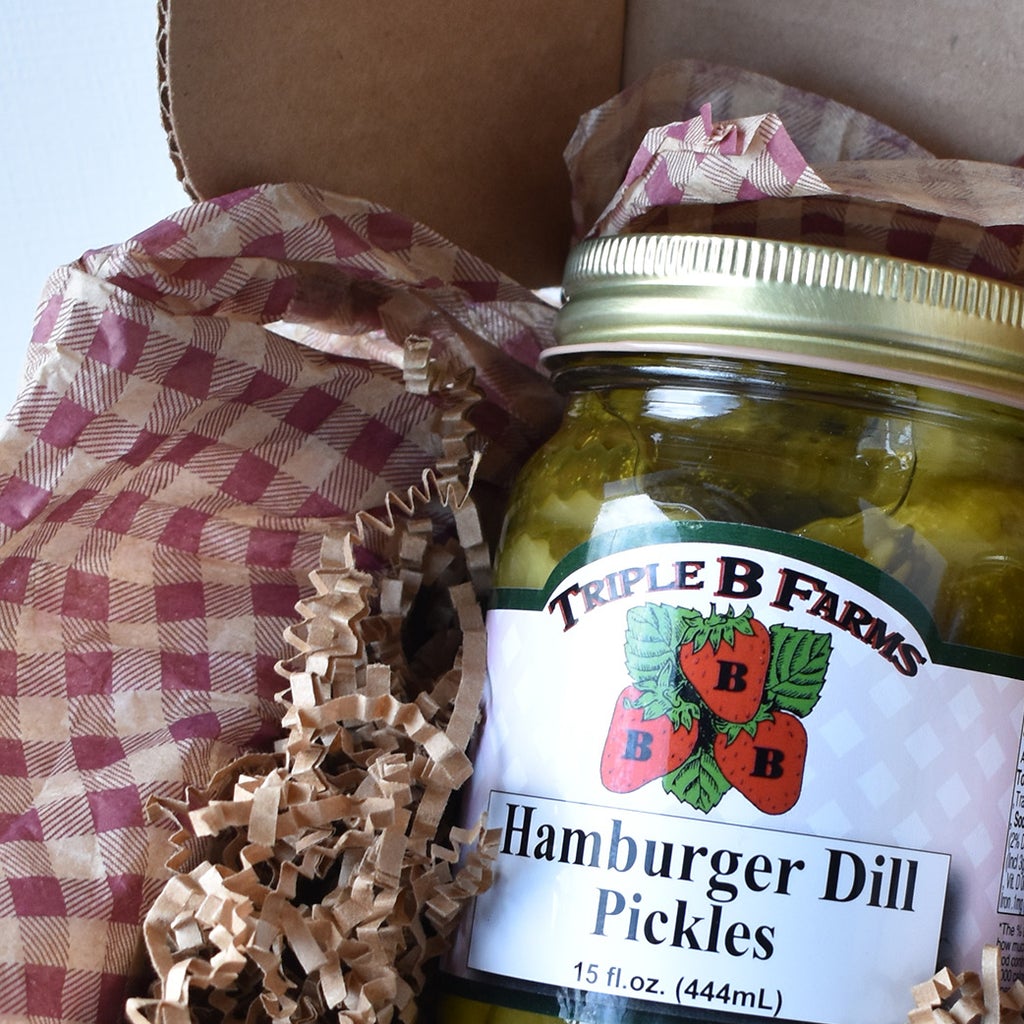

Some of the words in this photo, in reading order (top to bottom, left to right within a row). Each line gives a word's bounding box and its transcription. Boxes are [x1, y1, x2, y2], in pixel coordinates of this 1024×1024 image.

[548, 561, 705, 632] TRIPLE
[714, 556, 764, 599] B
[769, 568, 927, 677] FARMS
[714, 660, 748, 692] B
[621, 729, 654, 761] B
[750, 746, 785, 779] B
[500, 803, 805, 903] Hamburger
[819, 848, 919, 912] Dill
[589, 887, 776, 960] Pickles
[574, 961, 599, 984] 15
[606, 966, 665, 995] fl.oz.
[675, 976, 783, 1017] (444mL)
